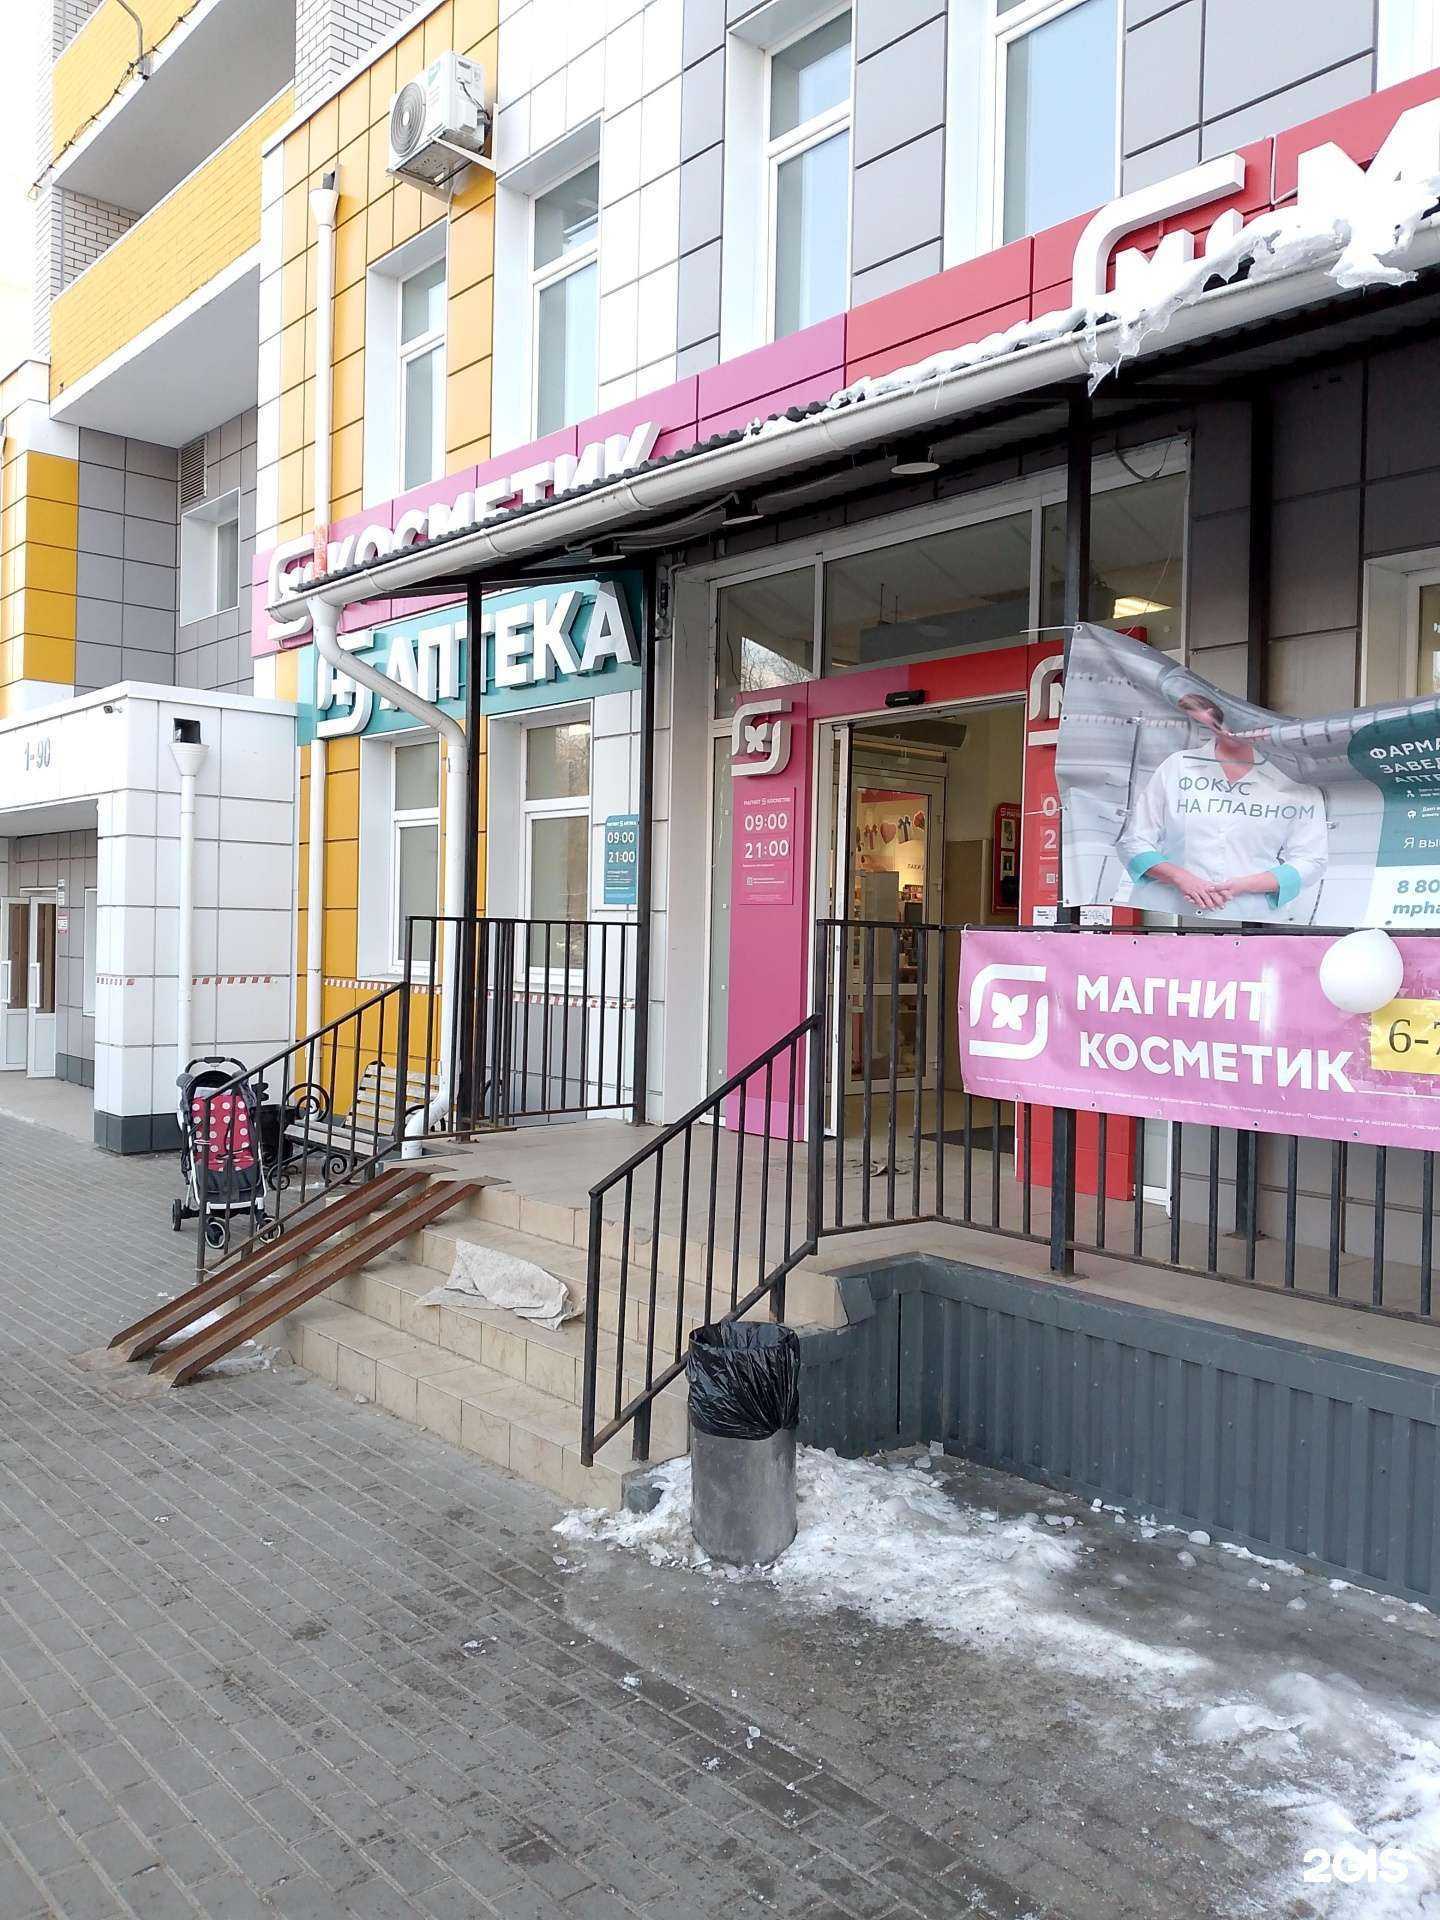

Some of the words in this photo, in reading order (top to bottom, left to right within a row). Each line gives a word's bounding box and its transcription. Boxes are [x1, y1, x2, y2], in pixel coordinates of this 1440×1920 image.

[24, 737, 51, 771] 1-90
[1178, 776, 1252, 796] ФОКУС
[1177, 798, 1201, 814] НА
[1207, 798, 1315, 819] ГЛАВНОМ
[744, 812, 788, 832] 09:00
[607, 831, 635, 844] 09:00
[1403, 837, 1415, 849] Я
[1419, 839, 1440, 849] вы
[608, 851, 636, 863] 21:00
[743, 839, 789, 859] 21:00
[1397, 880, 1409, 894] 8
[1076, 974, 1271, 1024] МАГНИТ
[1079, 1031, 1357, 1094] КОСМЕТИК
